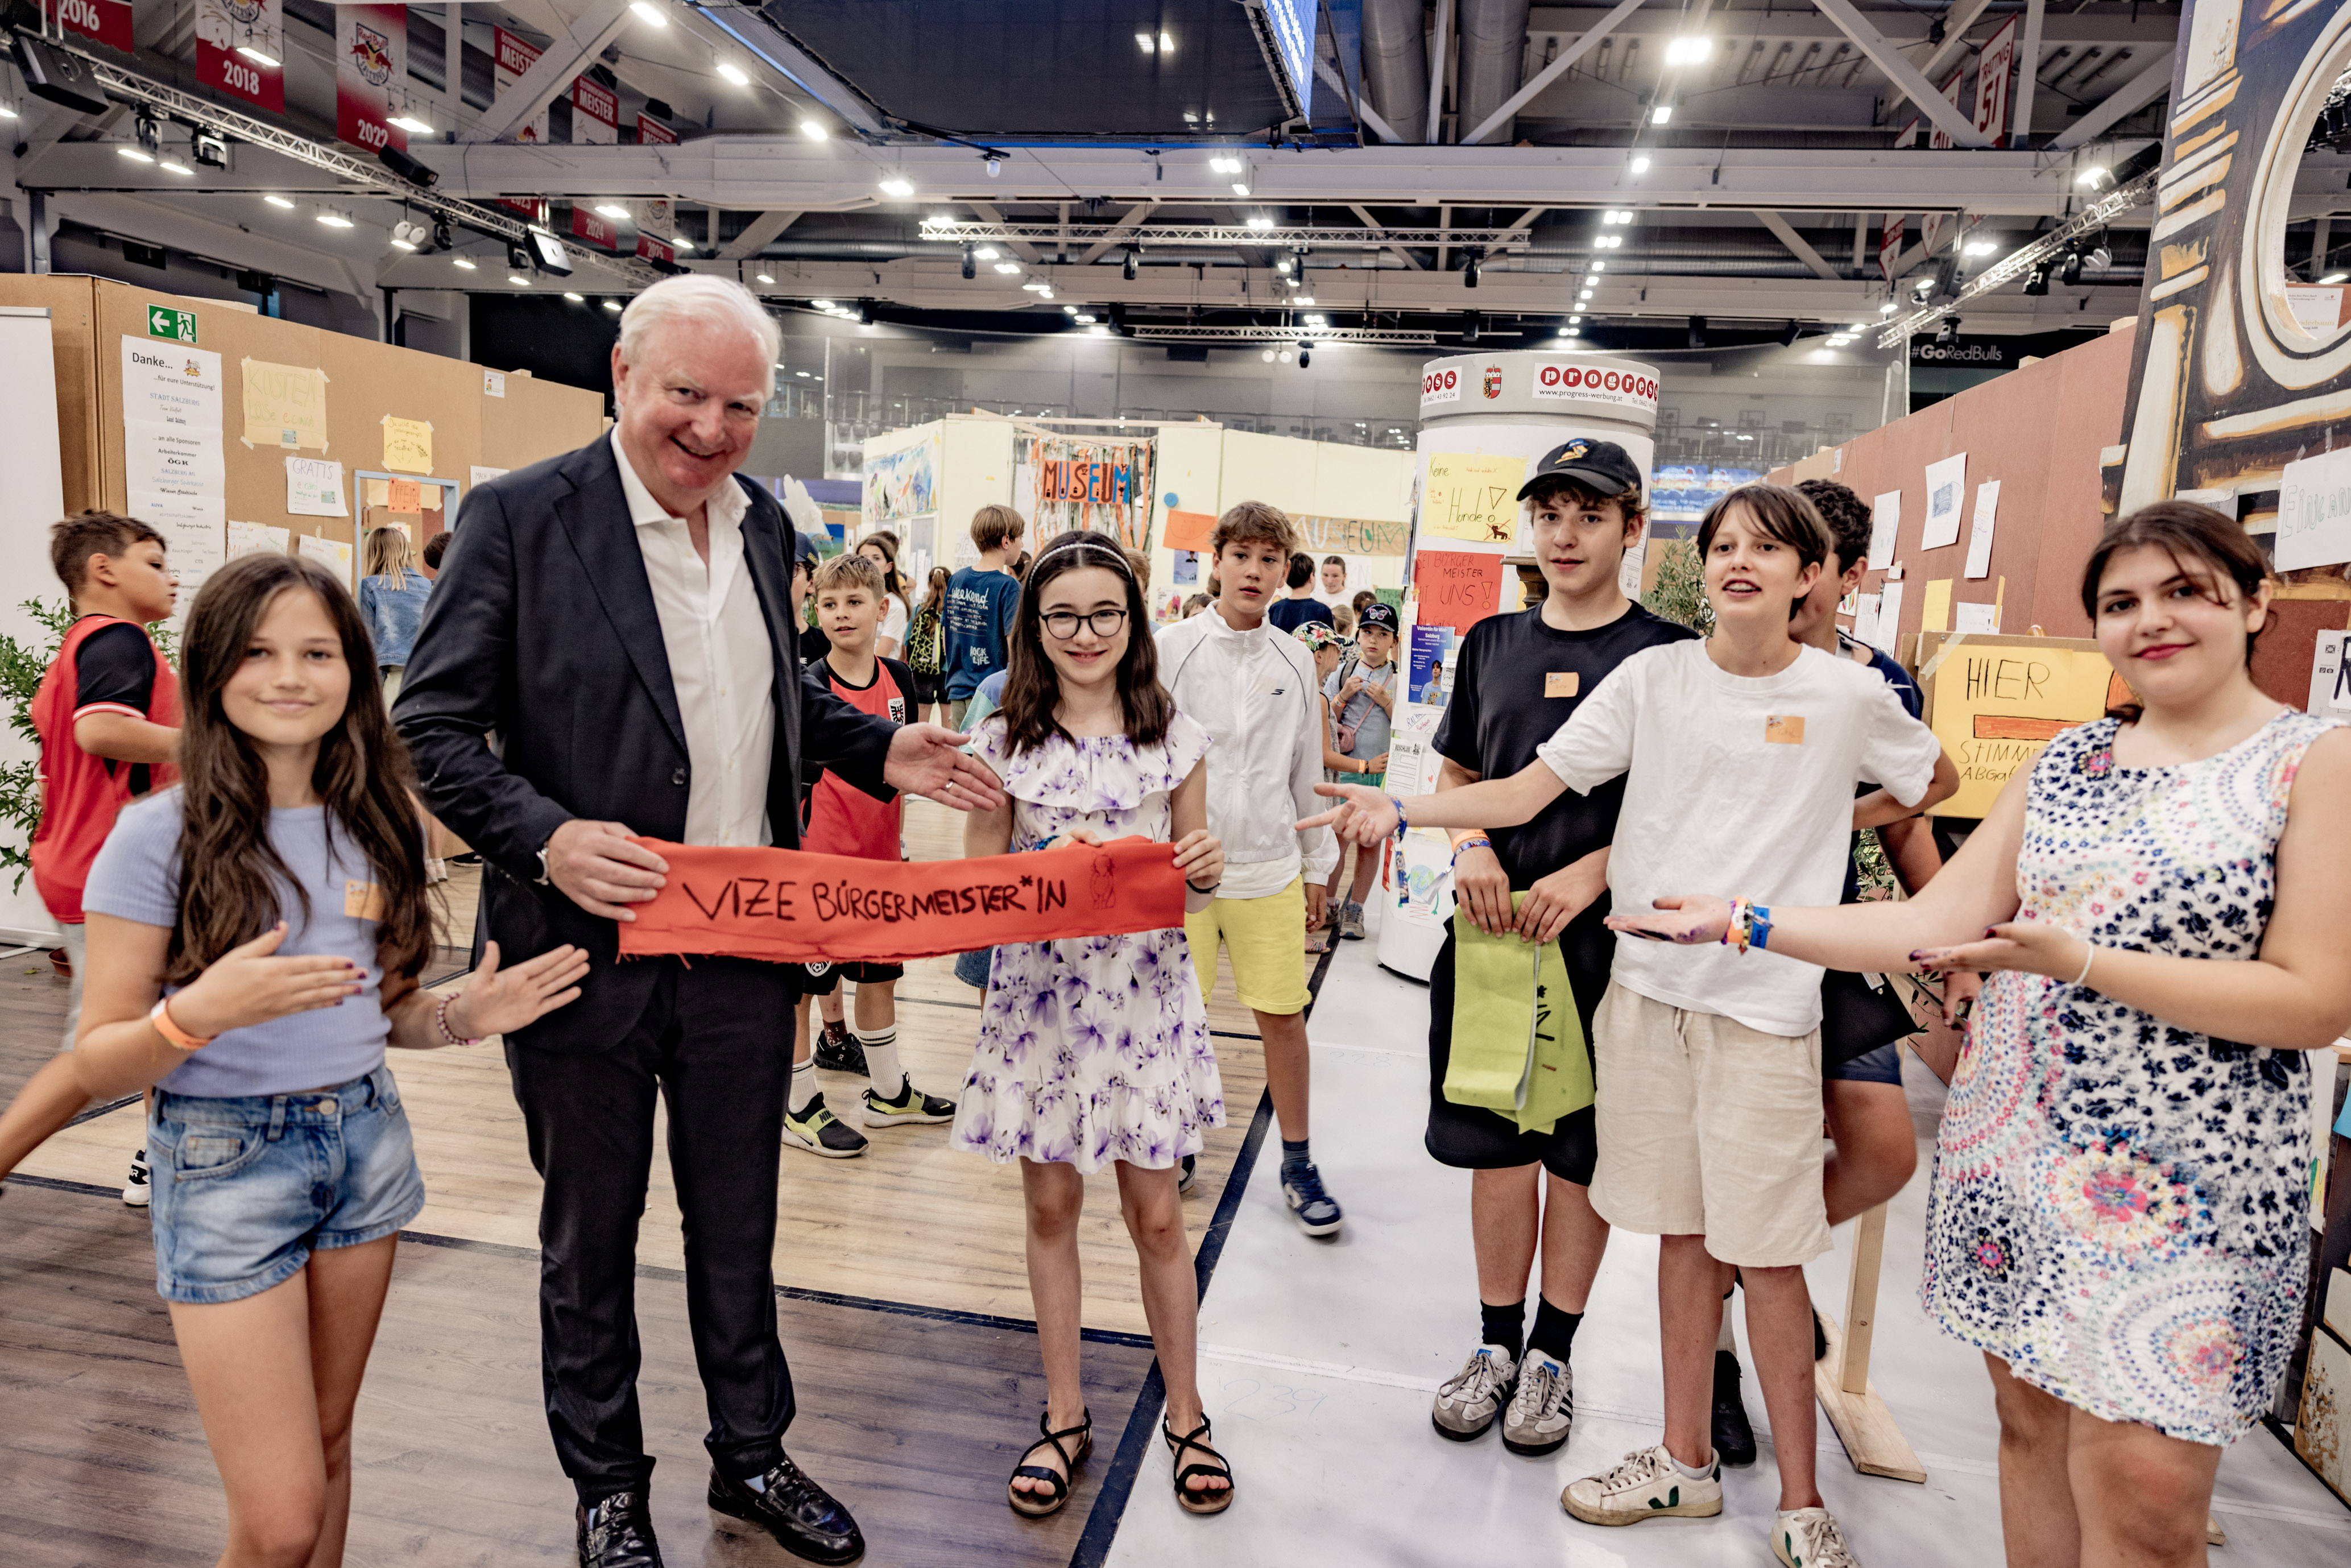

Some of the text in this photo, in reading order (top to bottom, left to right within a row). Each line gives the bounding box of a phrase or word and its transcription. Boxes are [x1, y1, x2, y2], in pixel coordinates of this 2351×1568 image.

[501, 44, 531, 73] MEIST
[223, 60, 259, 95] 2018
[579, 89, 614, 122] MEISTER
[1980, 75, 2000, 133] 51
[358, 119, 388, 148] 2022
[586, 218, 604, 240] 2024
[133, 352, 173, 369] Danke...
[1911, 344, 2002, 361] #GoRedBulls
[180, 380, 215, 391] Unterstützung!
[1542, 369, 1658, 400] progress
[150, 392, 200, 406] STADT SALZBURG
[1539, 390, 1622, 402] www.progress-werbung.at
[176, 437, 201, 446] Sponsoren
[158, 448, 196, 458] Arbeiterkammer
[168, 457, 189, 466] ÖGK
[293, 459, 333, 480] GRATIS
[1429, 457, 1449, 477] Keine
[1044, 461, 1131, 504] MUSEUM
[1418, 552, 1473, 569] SEI BÜRGER
[1443, 569, 1483, 578] MEISTER
[1967, 657, 2050, 701] HIER
[682, 877, 797, 921] VIZE
